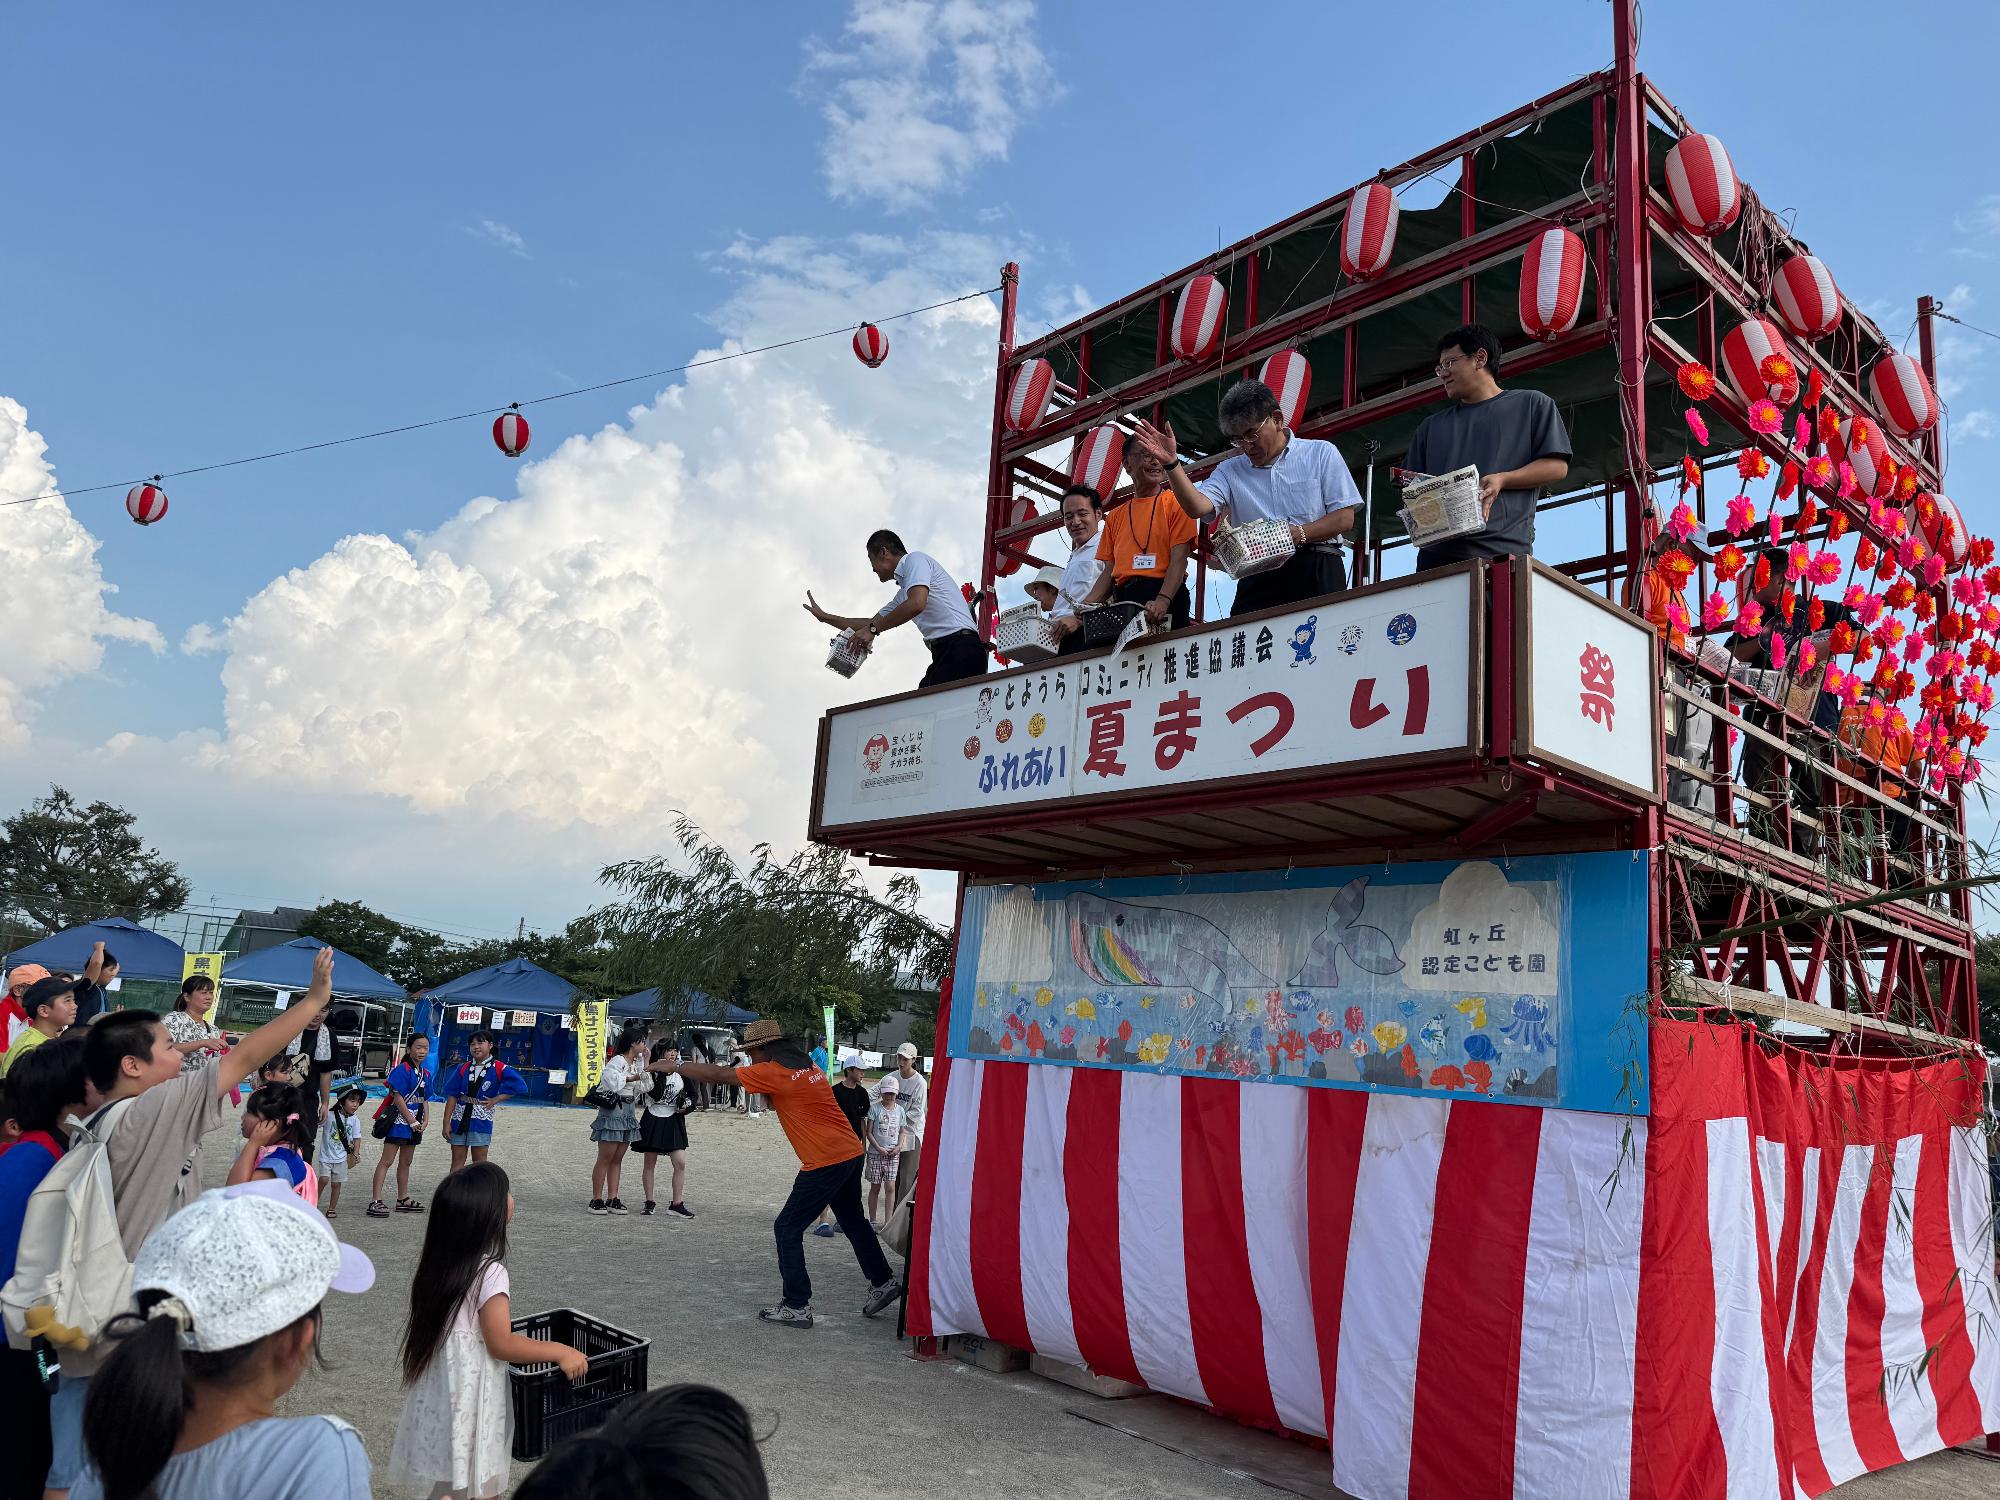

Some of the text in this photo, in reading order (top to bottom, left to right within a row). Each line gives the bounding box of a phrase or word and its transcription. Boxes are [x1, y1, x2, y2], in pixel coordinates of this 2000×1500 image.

[1005, 672, 1066, 711] とようら
[1579, 642, 1616, 733] 祭
[978, 664, 1430, 794] ふれあい 夏まつり
[1443, 923, 1506, 946] 虹ヶ丘
[1421, 953, 1546, 976] 認定こども園
[459, 1010, 480, 1021] 射的
